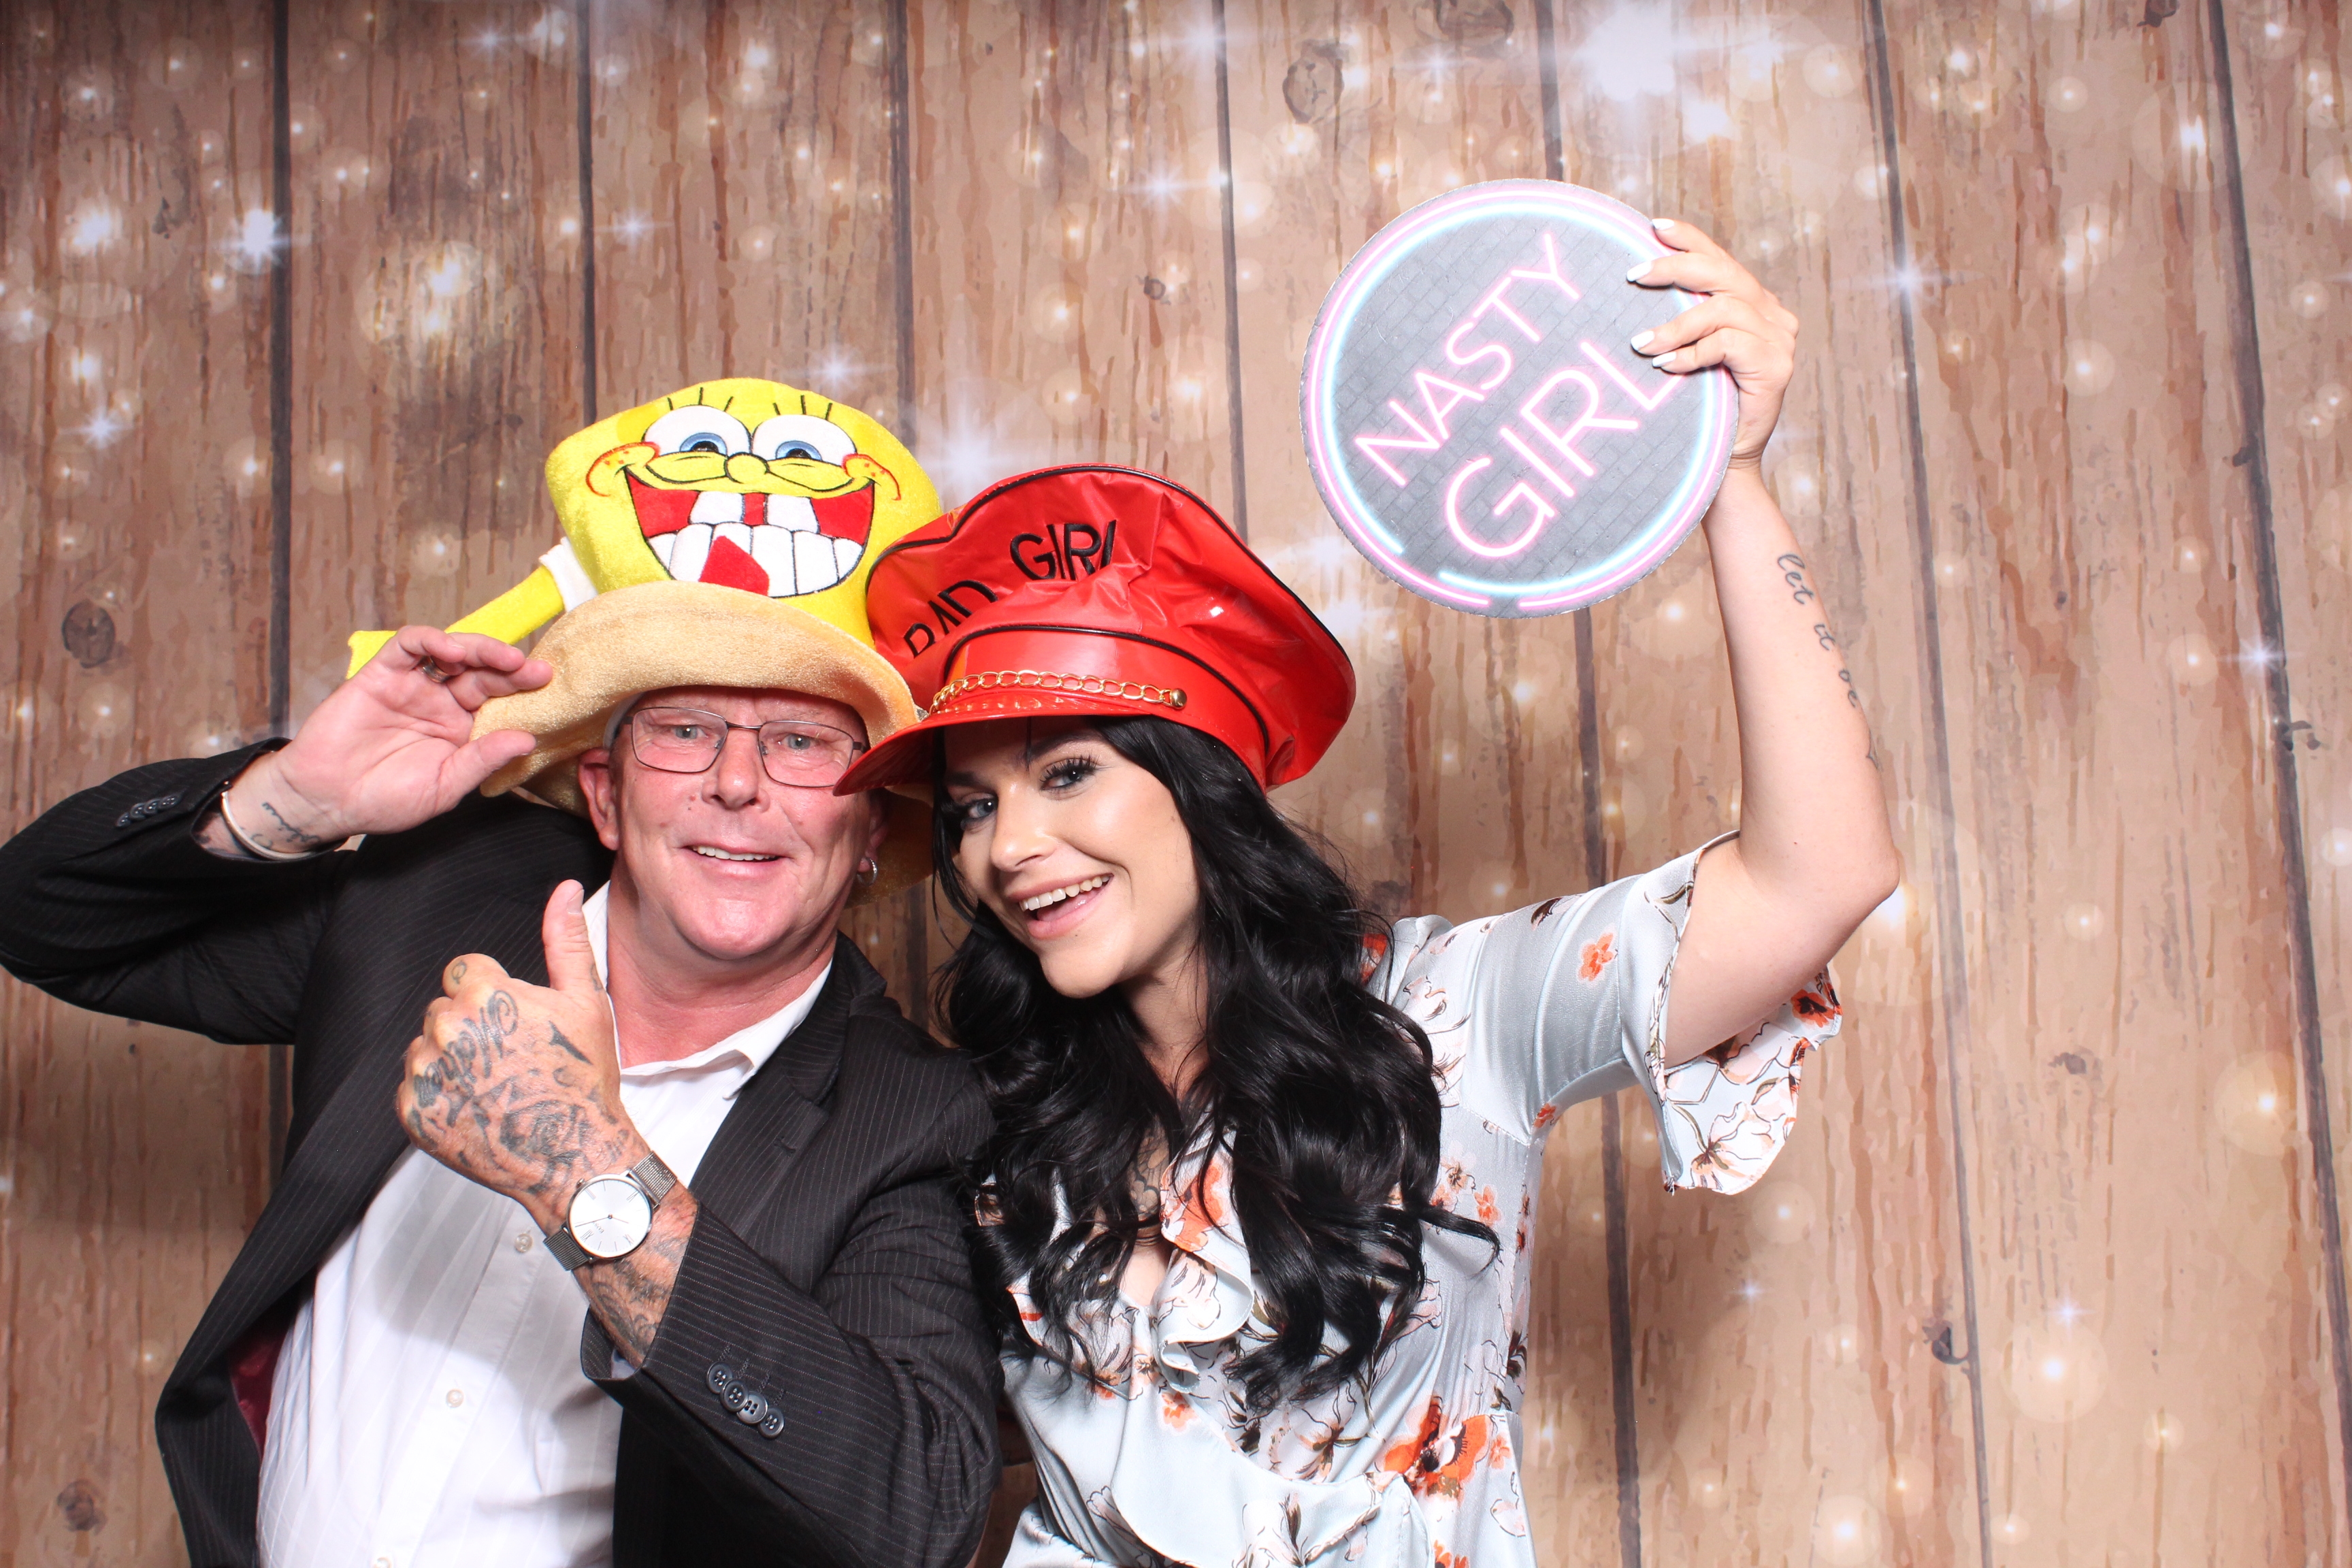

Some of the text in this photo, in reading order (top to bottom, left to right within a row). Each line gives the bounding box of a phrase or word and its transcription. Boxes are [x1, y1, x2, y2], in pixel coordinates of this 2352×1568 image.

[1354, 232, 1581, 487] NASTY
[1446, 340, 1684, 557] GIRL
[1778, 555, 1814, 604] let
[1815, 624, 1836, 651] it
